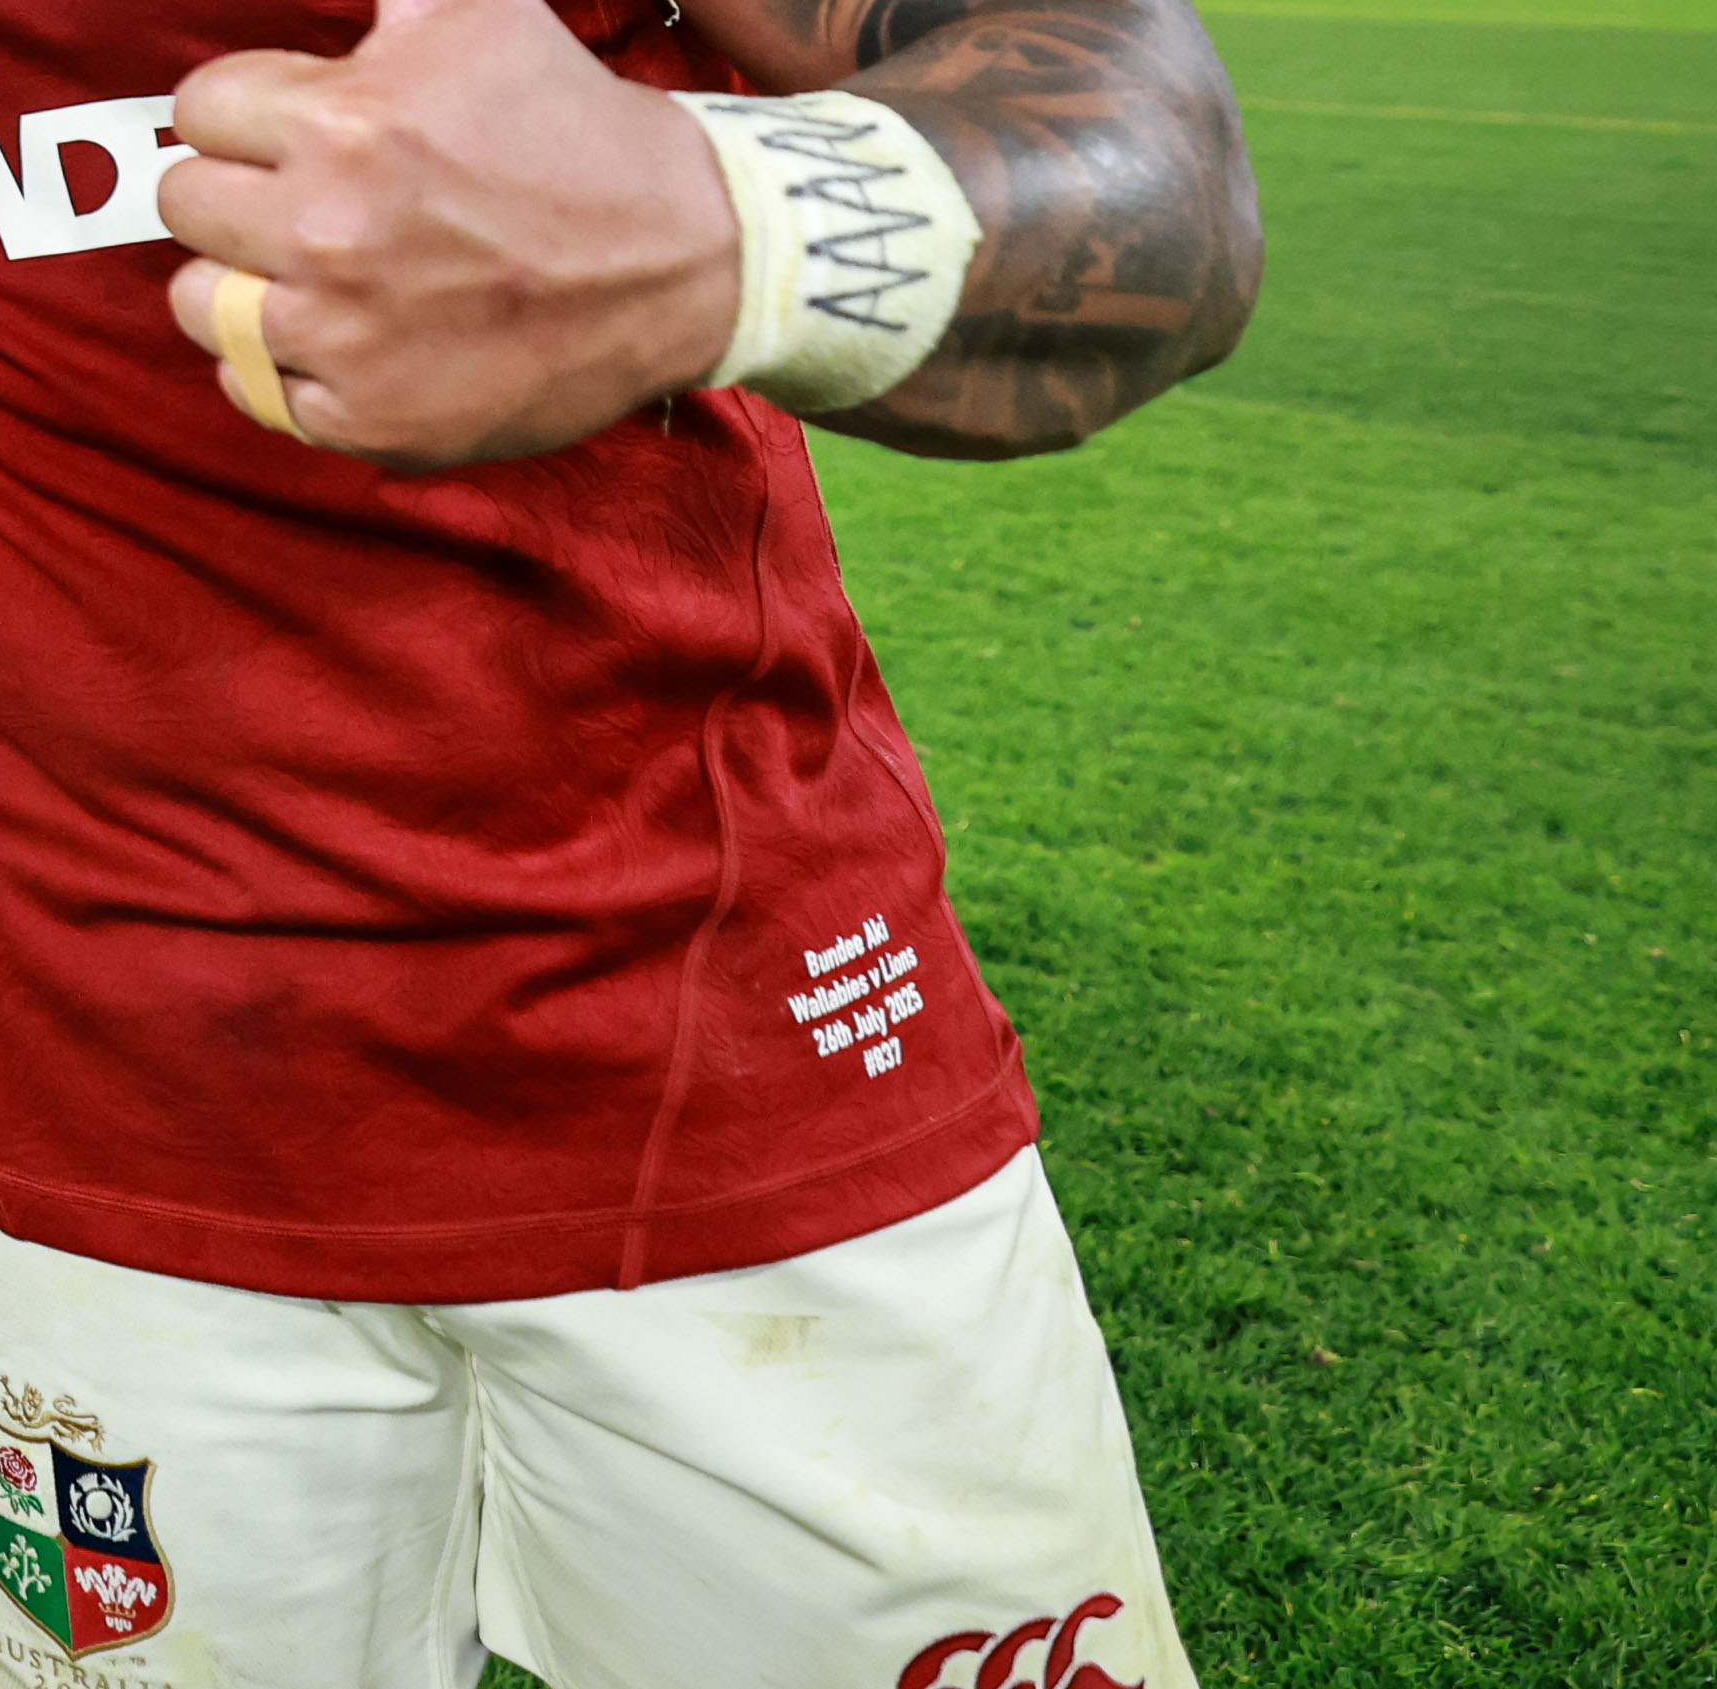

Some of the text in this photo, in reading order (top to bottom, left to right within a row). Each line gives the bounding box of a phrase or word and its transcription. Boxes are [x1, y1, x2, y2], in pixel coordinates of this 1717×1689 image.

[804, 913, 890, 979] Bundee Aki
[787, 946, 919, 1024] Wallabies v Lions
[812, 981, 924, 1057] 26th July 2025
[862, 1036, 903, 1079] #837
